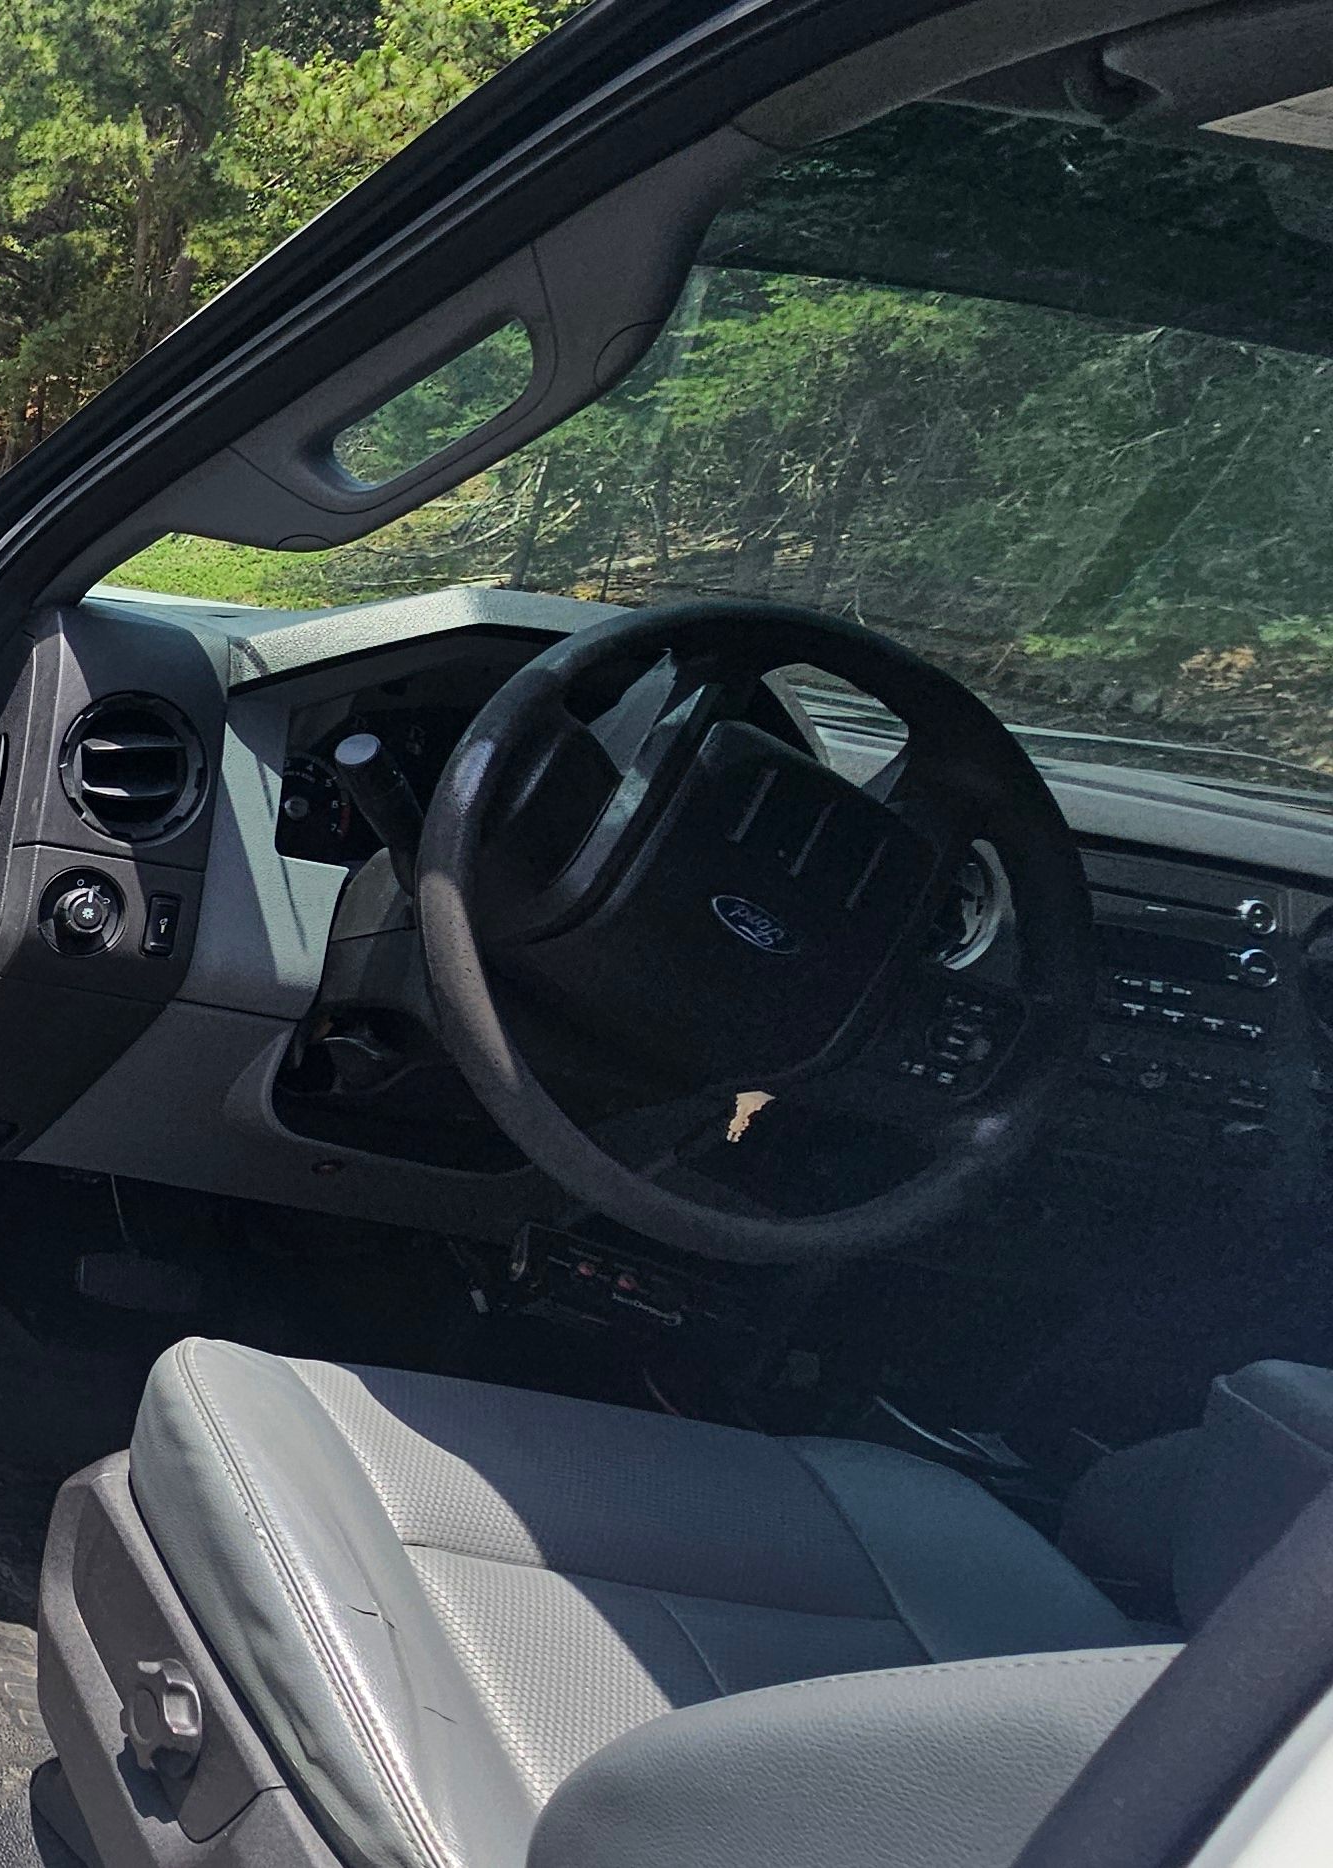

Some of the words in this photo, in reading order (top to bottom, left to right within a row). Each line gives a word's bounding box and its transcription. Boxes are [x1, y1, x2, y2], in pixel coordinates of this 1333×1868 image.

[324, 779, 332, 788] 5
[332, 800, 339, 809] 6
[728, 905, 785, 945] Ford
